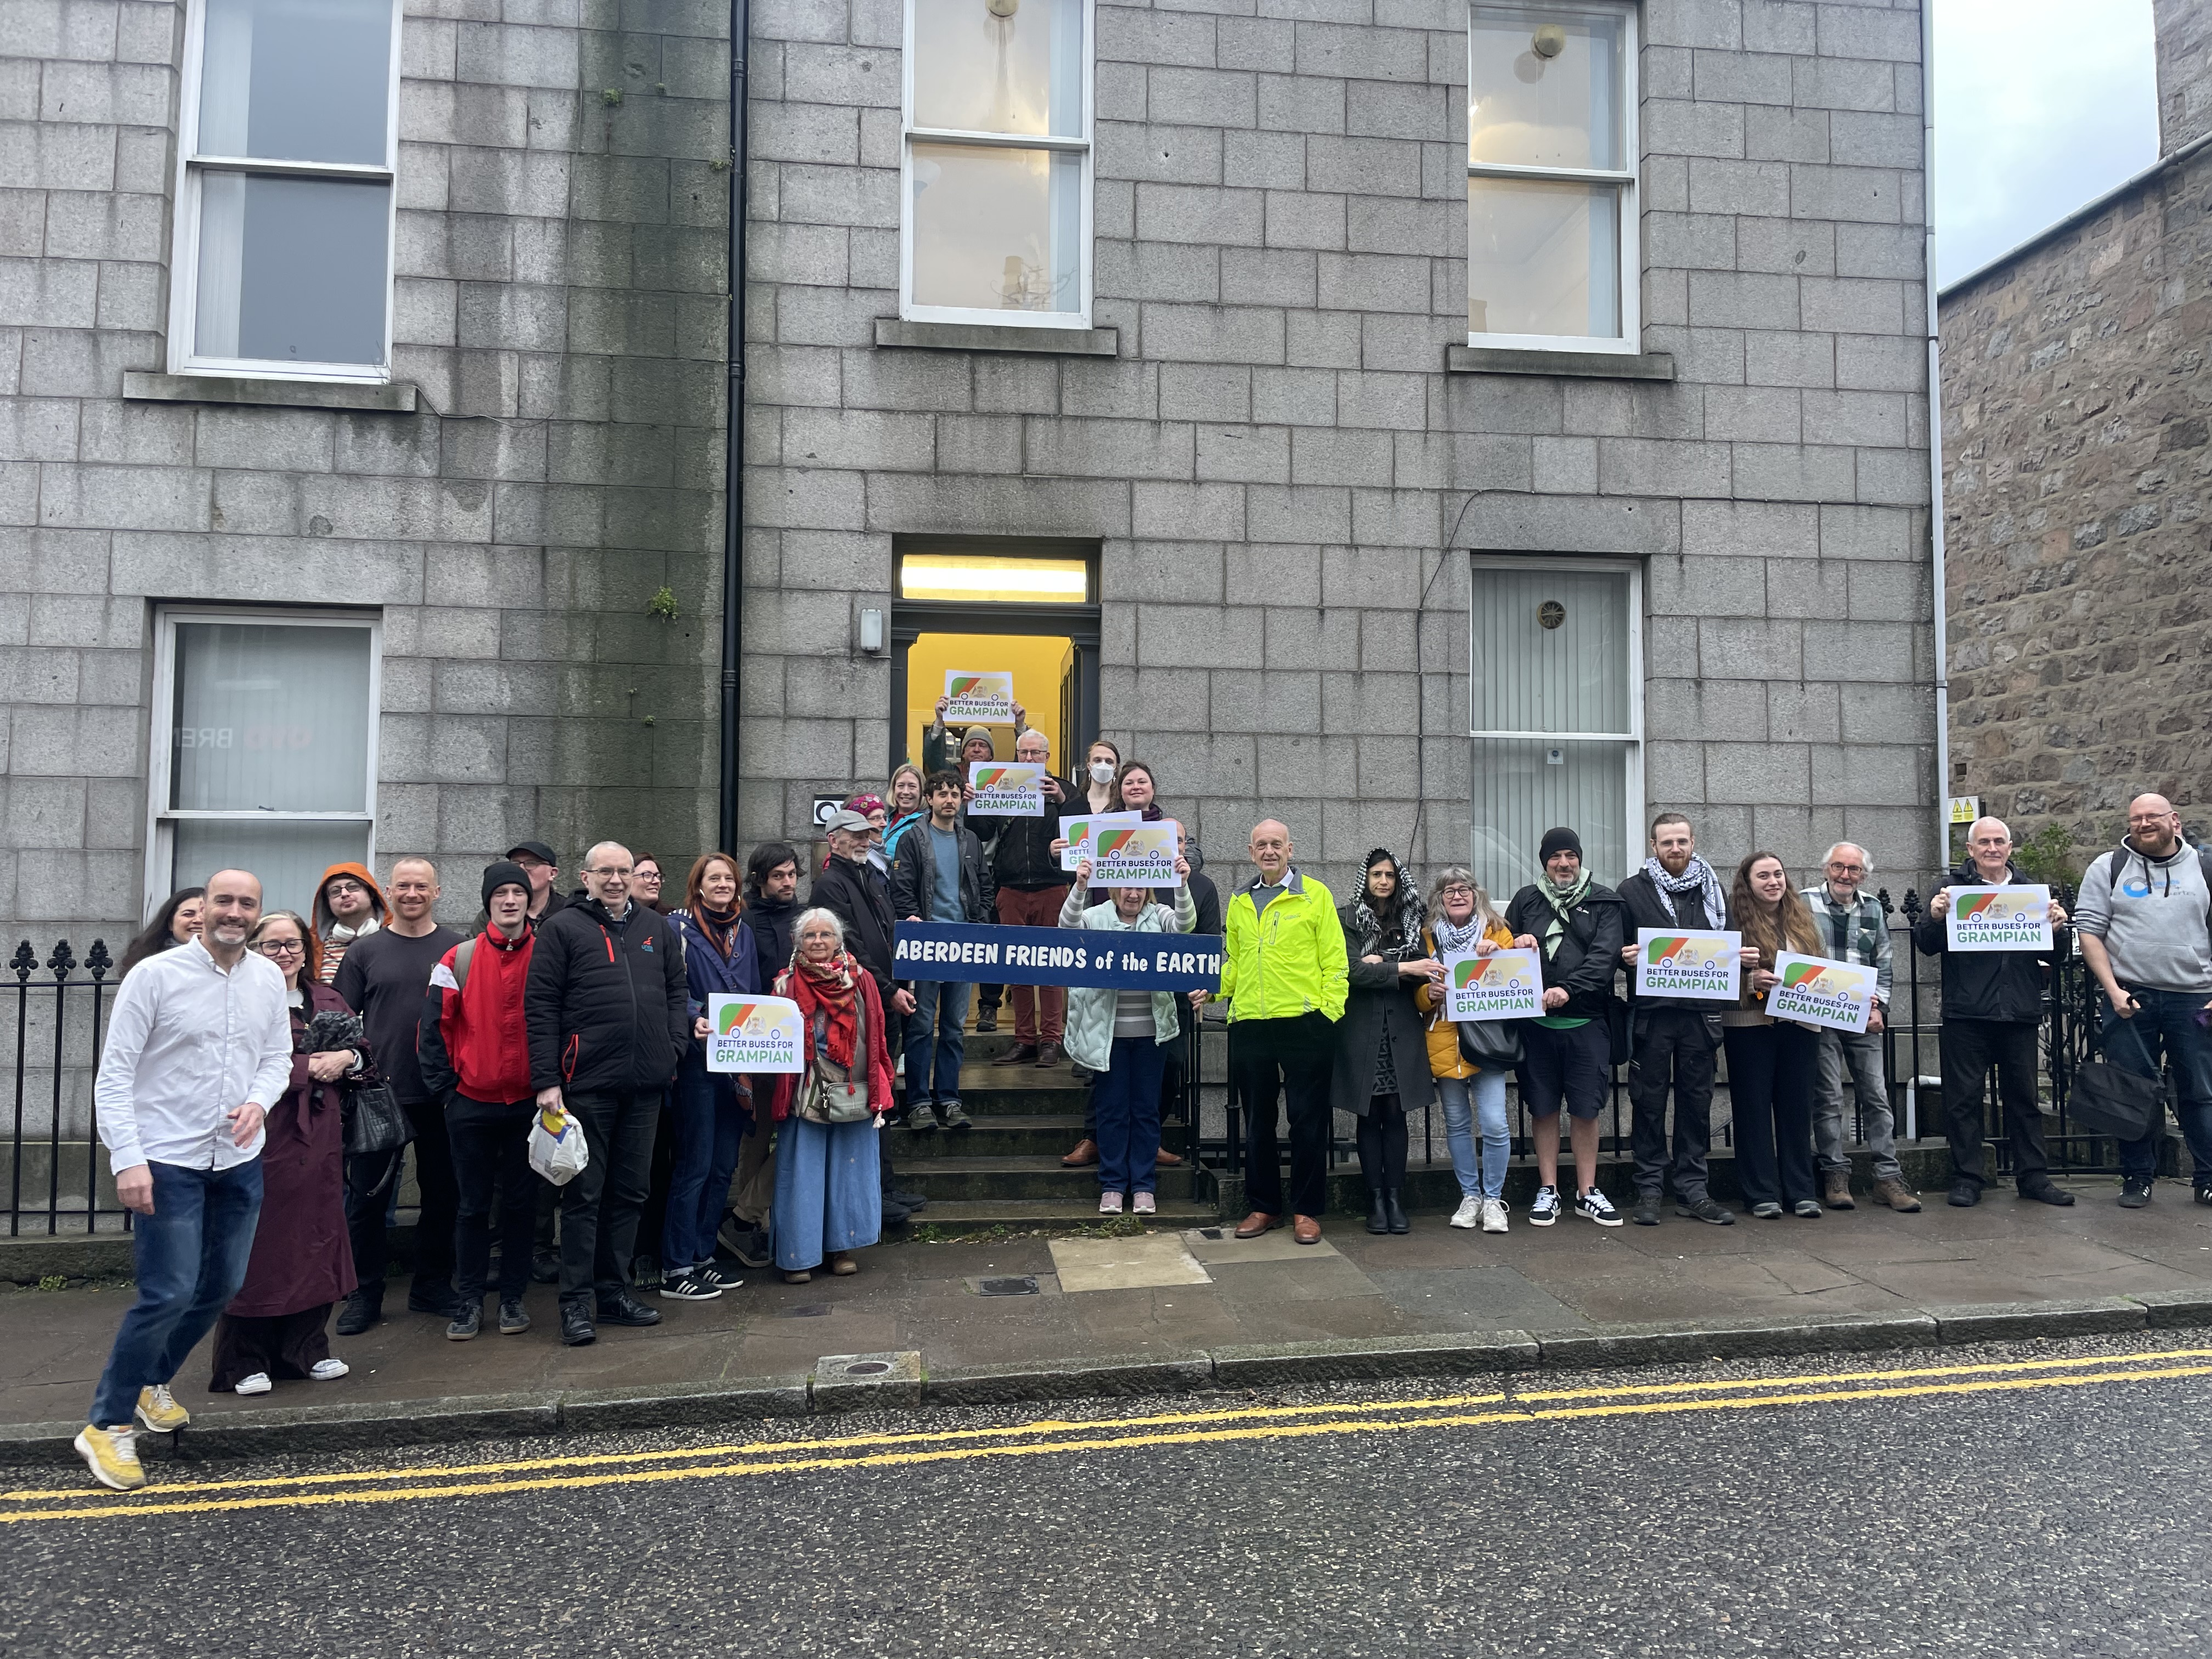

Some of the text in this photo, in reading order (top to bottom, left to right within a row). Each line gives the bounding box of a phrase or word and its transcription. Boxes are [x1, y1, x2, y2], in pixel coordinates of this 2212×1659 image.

[950, 706, 1008, 716] GRAMPIAN
[975, 800, 1036, 810] GRAMPIAN
[1096, 868, 1172, 879] GRAMPIAN
[1957, 931, 2041, 943] GRAMPIAN
[895, 939, 998, 964] ABERDEEN
[1006, 945, 1087, 969] FRIENDS
[1095, 950, 1114, 970] of
[1122, 951, 1148, 972] the
[1156, 951, 1221, 975] EARTH
[1646, 977, 1728, 991] GRAMPIAN
[1455, 991, 1487, 1000] BETTER
[1779, 990, 1860, 1012] BETTER BUSES FOR
[1456, 997, 1534, 1013] GRAMPIAN
[1776, 998, 1858, 1024] GRAMPIAN
[715, 1049, 793, 1063] GRAMPIAN
